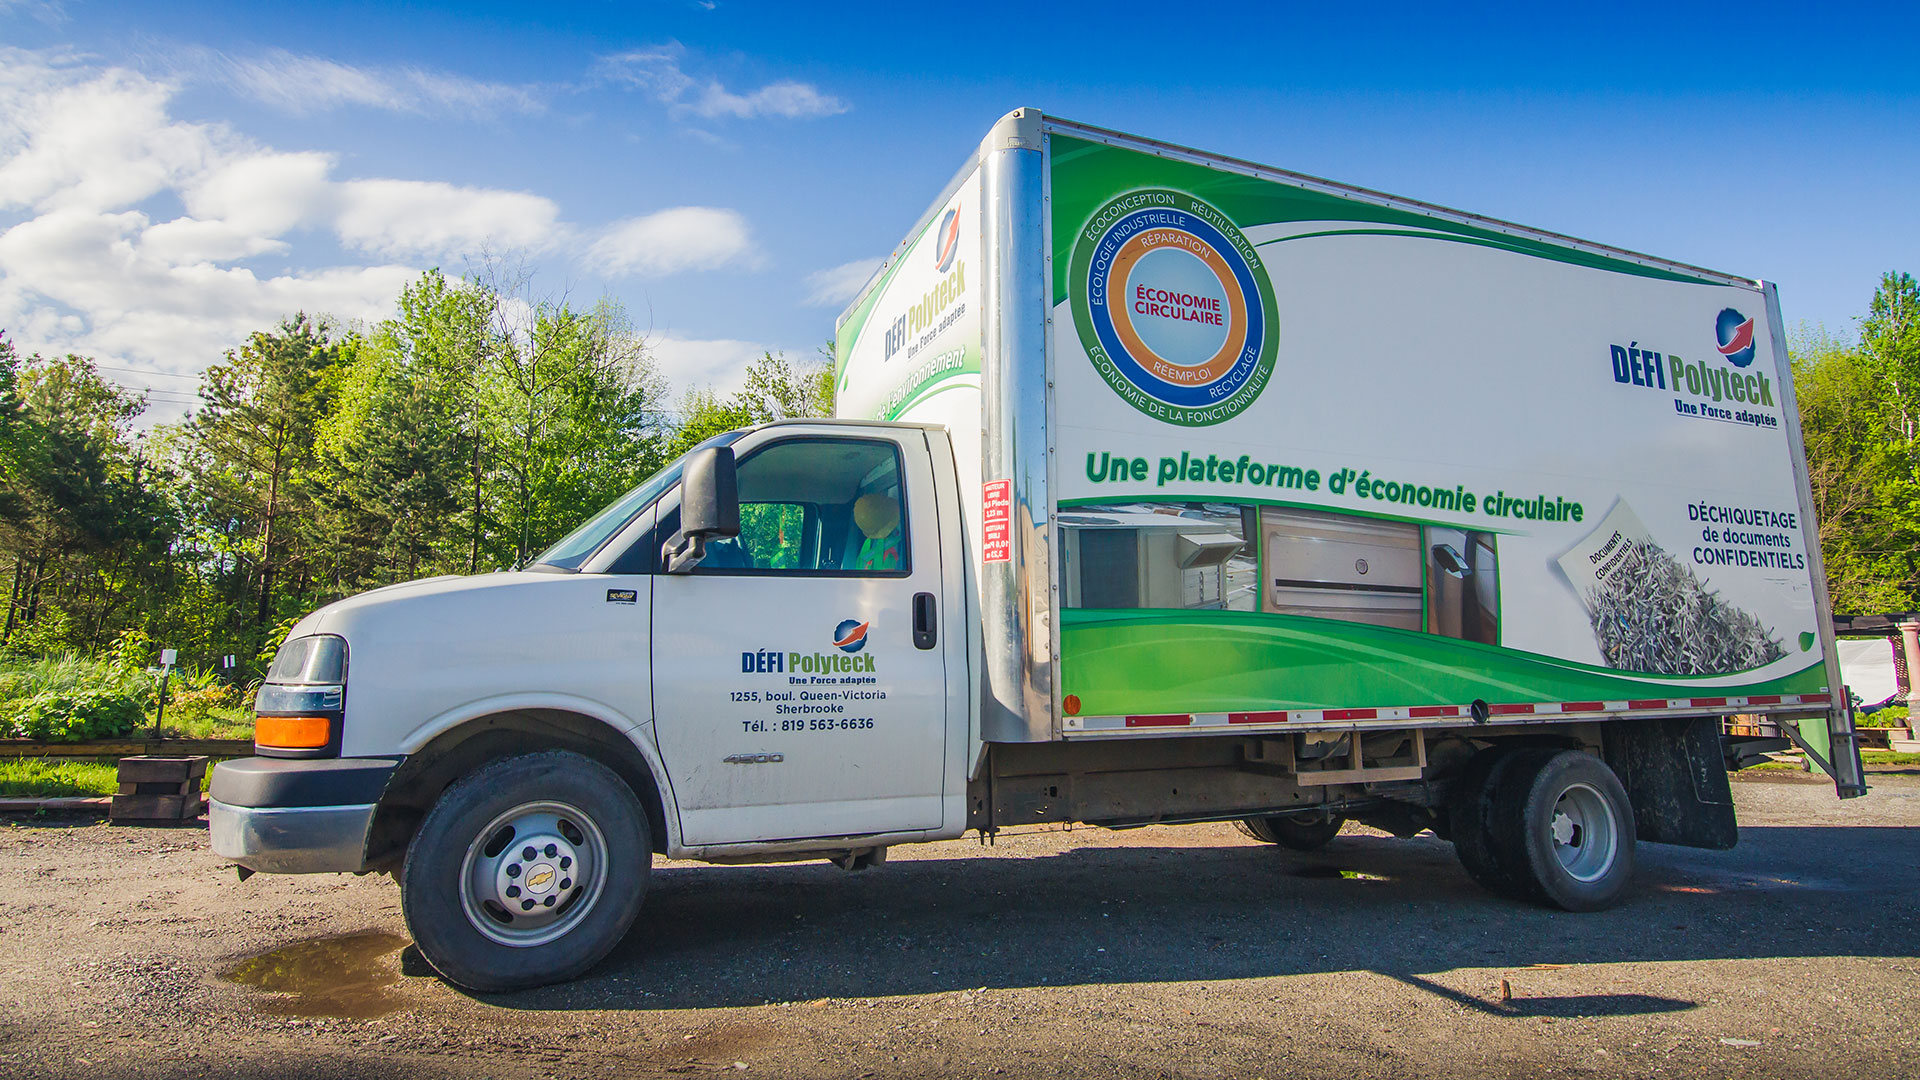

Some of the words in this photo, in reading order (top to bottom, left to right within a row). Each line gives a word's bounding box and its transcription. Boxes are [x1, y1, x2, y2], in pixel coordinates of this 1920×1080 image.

[1085, 193, 1175, 242] ÉCOCONCEPTION
[1140, 232, 1211, 259] RÉPARATION
[1190, 201, 1260, 270] RÉUTILISATION
[1091, 239, 1115, 306] ÉCOLOGIE
[1111, 213, 1186, 242] INDUSTRIELLE
[884, 314, 906, 362] DÉFI
[908, 258, 966, 341] Polyteck
[1136, 284, 1221, 312] ÉCONOMIE
[1134, 301, 1223, 327] CIRCULAIRE
[907, 344, 918, 359] Une
[919, 327, 937, 349] Force
[938, 303, 966, 334] adaptée
[1089, 345, 1147, 408] ÉCONOMIE
[1148, 401, 1165, 417] DE
[1168, 409, 1184, 422] LA
[1187, 364, 1269, 423] FONCTIONNALITÉ
[1153, 361, 1212, 382] RÉEMPLOI
[1208, 346, 1257, 399] RECYCLAGE
[1609, 341, 1666, 390] DÉFI
[1668, 354, 1775, 408] Polyteck
[1674, 399, 1698, 415] Une
[1700, 403, 1732, 420] Force
[1735, 410, 1778, 427] adaptée
[1086, 451, 1149, 483] Une
[1157, 450, 1321, 491] plateforme
[1328, 468, 1477, 513] d'économie
[1483, 490, 1584, 523] circulaire
[1688, 500, 1797, 529] DÉCHIQUETAGE
[1589, 530, 1622, 565] DOCUMENTS
[1702, 526, 1719, 543] de
[1722, 527, 1791, 548] documents
[1595, 538, 1633, 580] CONFIDENTIELS
[1693, 547, 1805, 570] CONFIDENTIELS
[741, 648, 784, 673] DÉFI
[789, 652, 876, 675] Polyteck
[789, 677, 808, 685] Une
[810, 676, 837, 685] Force
[839, 675, 876, 686] adaptée
[730, 692, 762, 703] 1255,
[766, 691, 796, 702] boul.
[800, 689, 887, 701] Queen-Victoria
[776, 704, 844, 714] Sherbrooke
[742, 720, 768, 732] Tél.
[781, 719, 805, 731] 819
[809, 718, 874, 731] 563-6636
